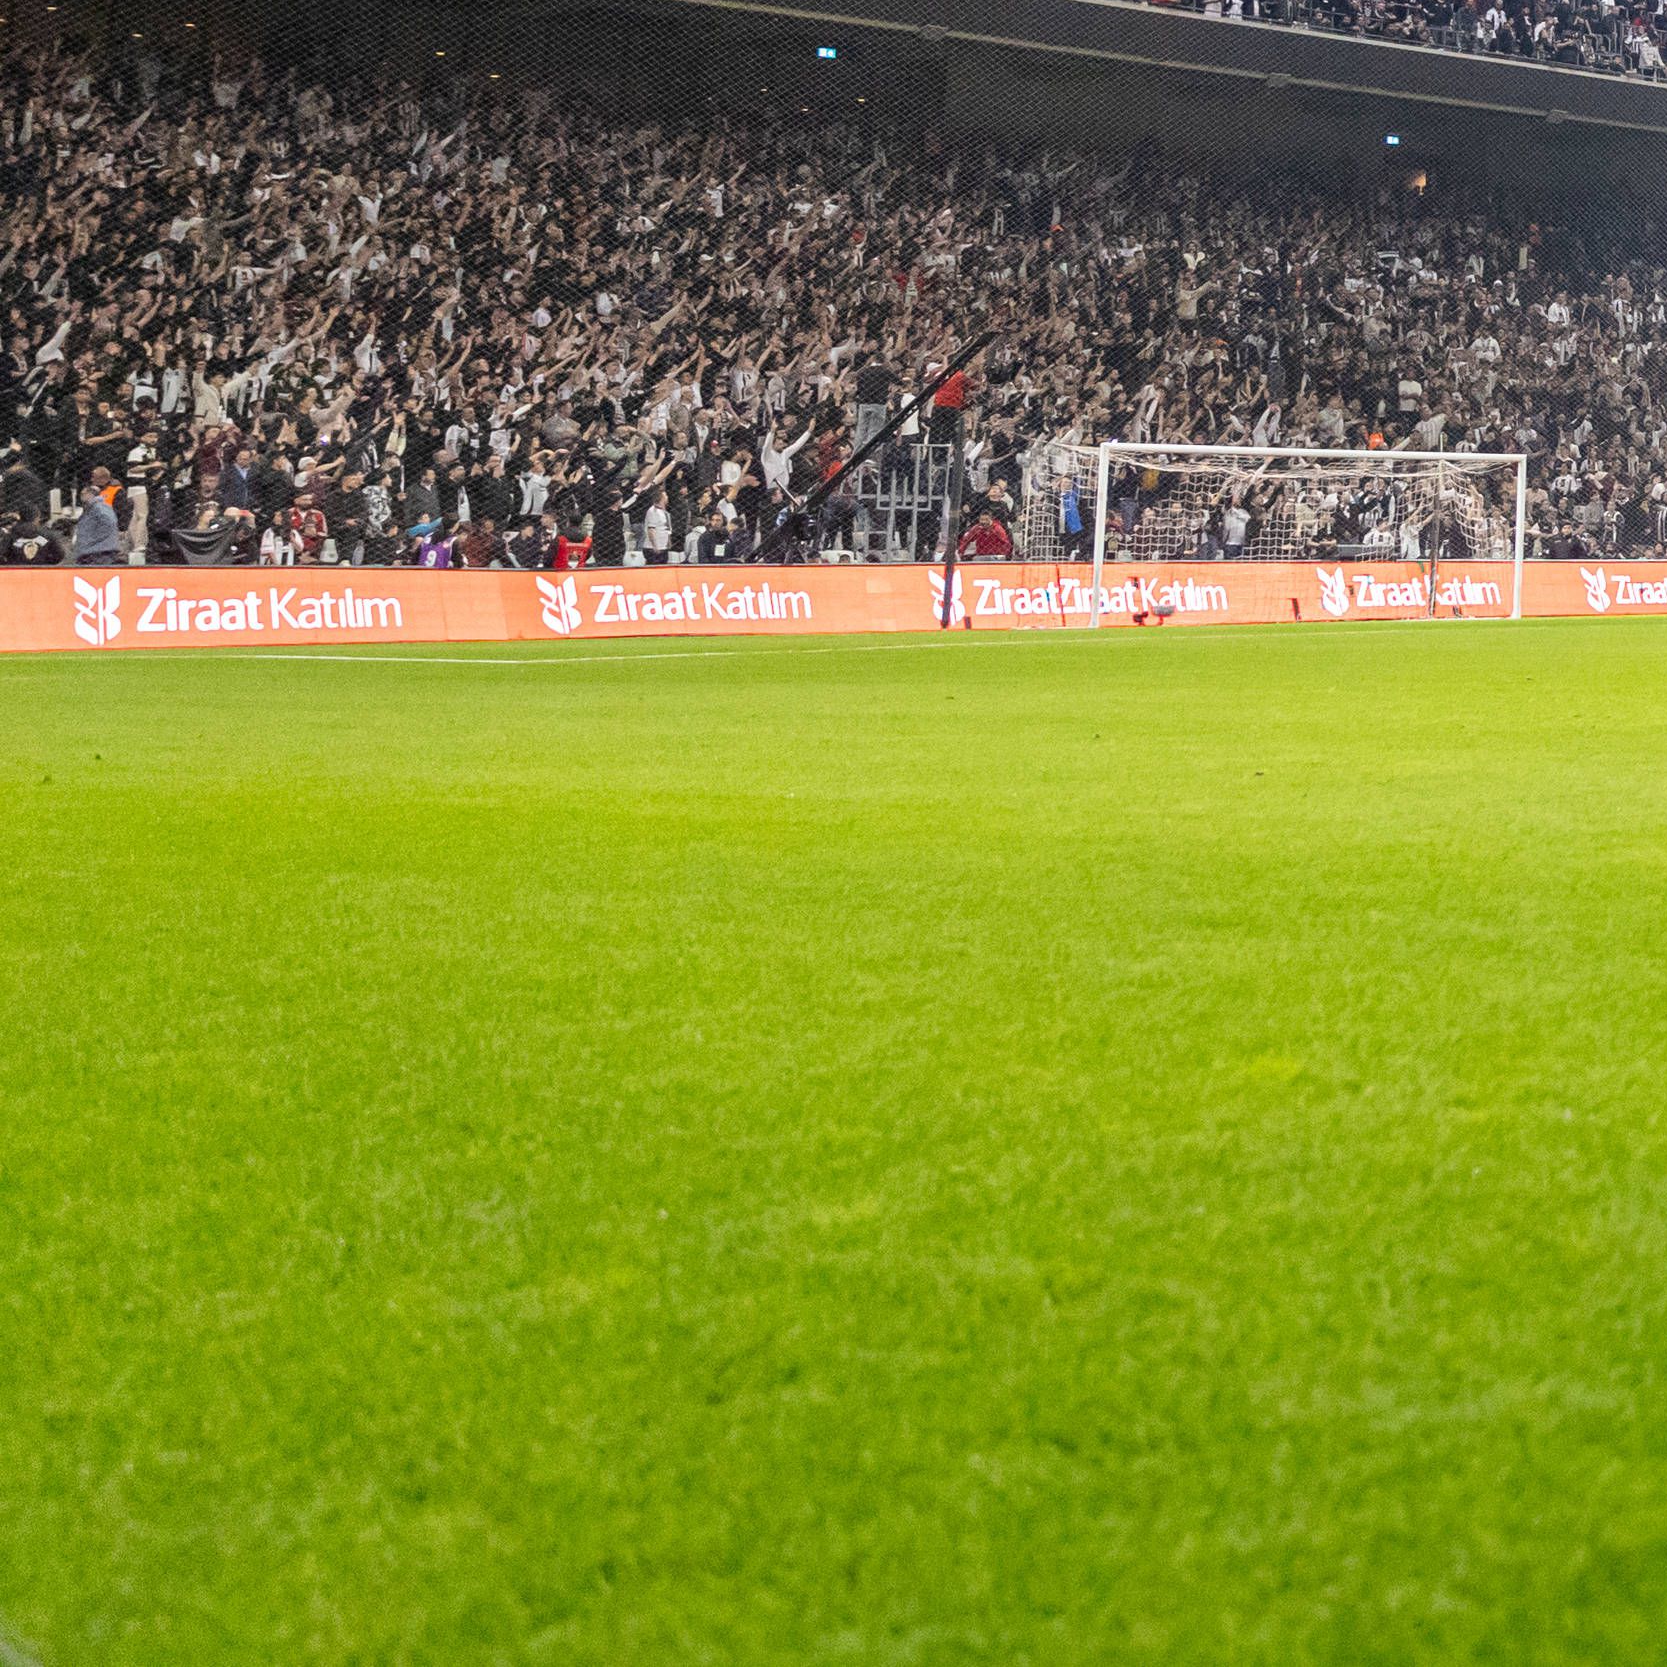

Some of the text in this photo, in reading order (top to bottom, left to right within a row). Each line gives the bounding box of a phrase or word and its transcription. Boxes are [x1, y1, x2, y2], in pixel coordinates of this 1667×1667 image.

[425, 550, 437, 567] 9
[136, 588, 403, 632] Ziraat Katılım
[590, 582, 812, 623] Ziraat Katılım
[973, 579, 1061, 615] Ziraat
[1139, 577, 1229, 612] Katılım
[1352, 575, 1425, 607] Ziraat
